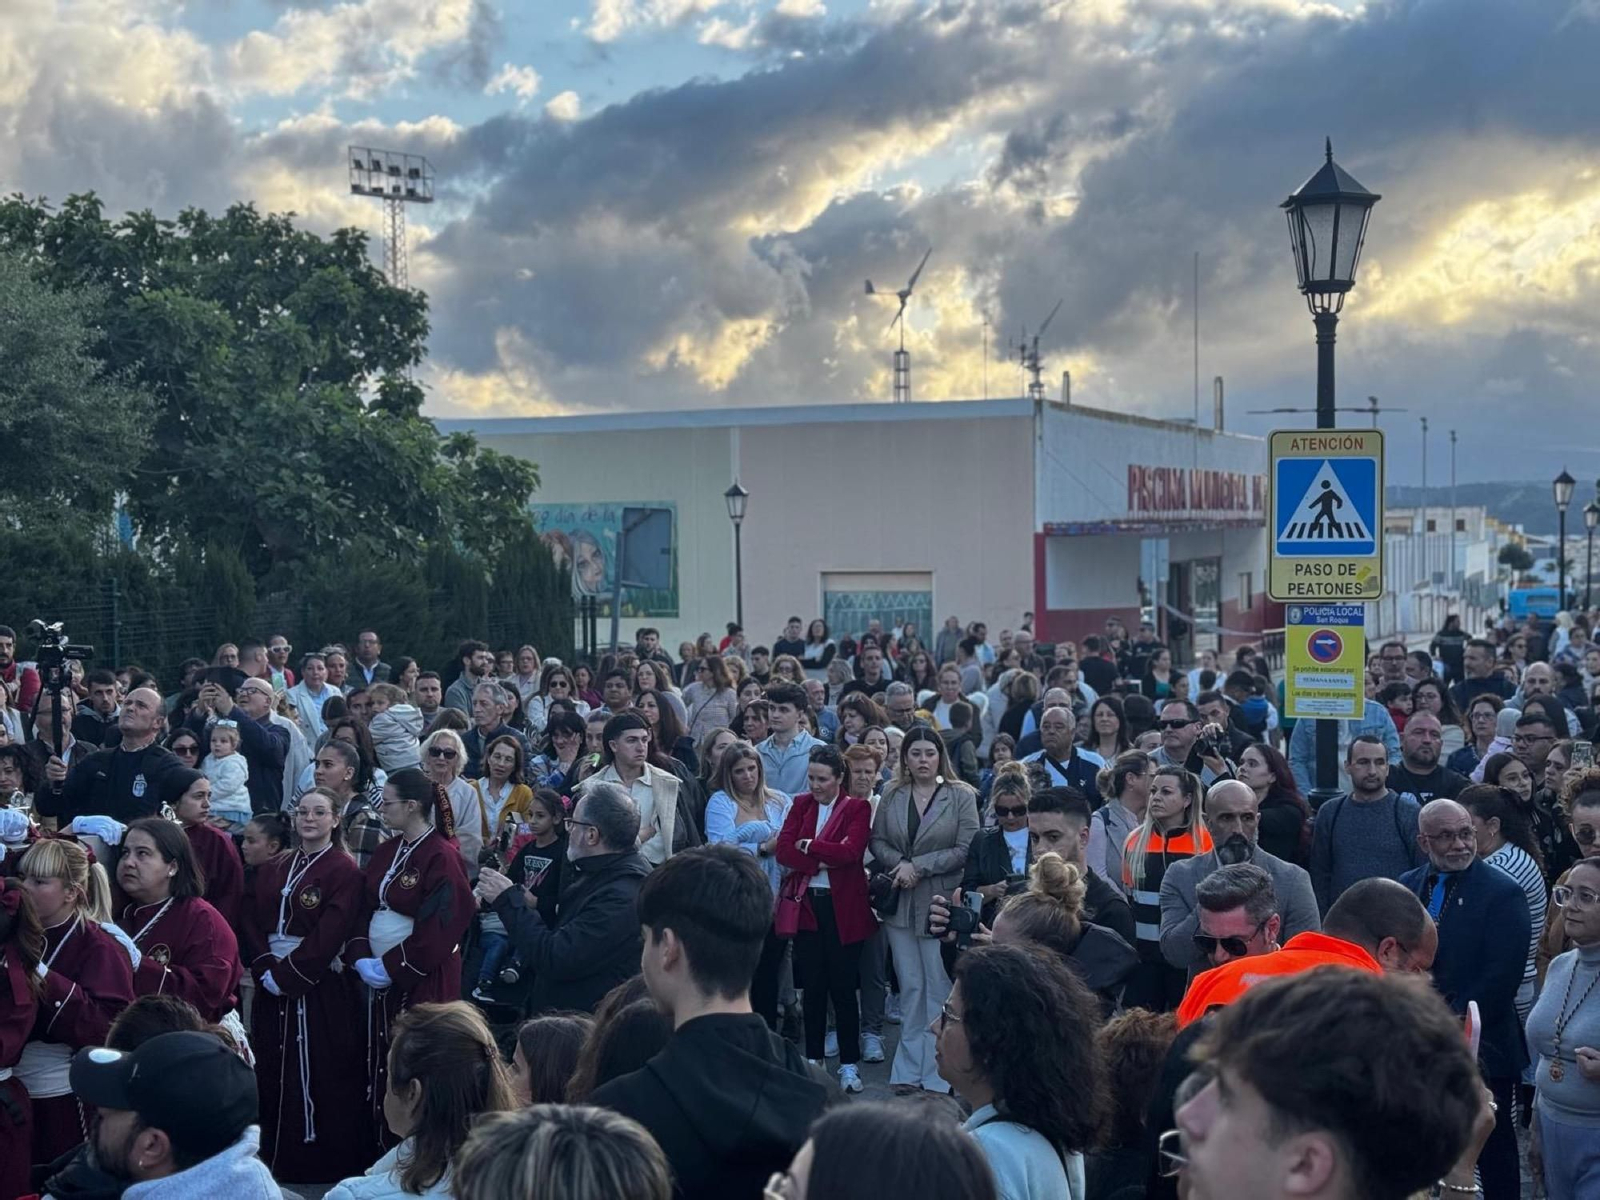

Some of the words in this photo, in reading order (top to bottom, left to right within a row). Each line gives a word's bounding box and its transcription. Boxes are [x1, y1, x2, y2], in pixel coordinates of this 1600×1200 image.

[1291, 435, 1364, 450] ATENCIÓN
[1295, 564, 1333, 576] PASO
[1338, 564, 1357, 576] DE
[1287, 582, 1363, 595] PEATONES
[1337, 607, 1364, 617] LOCAL
